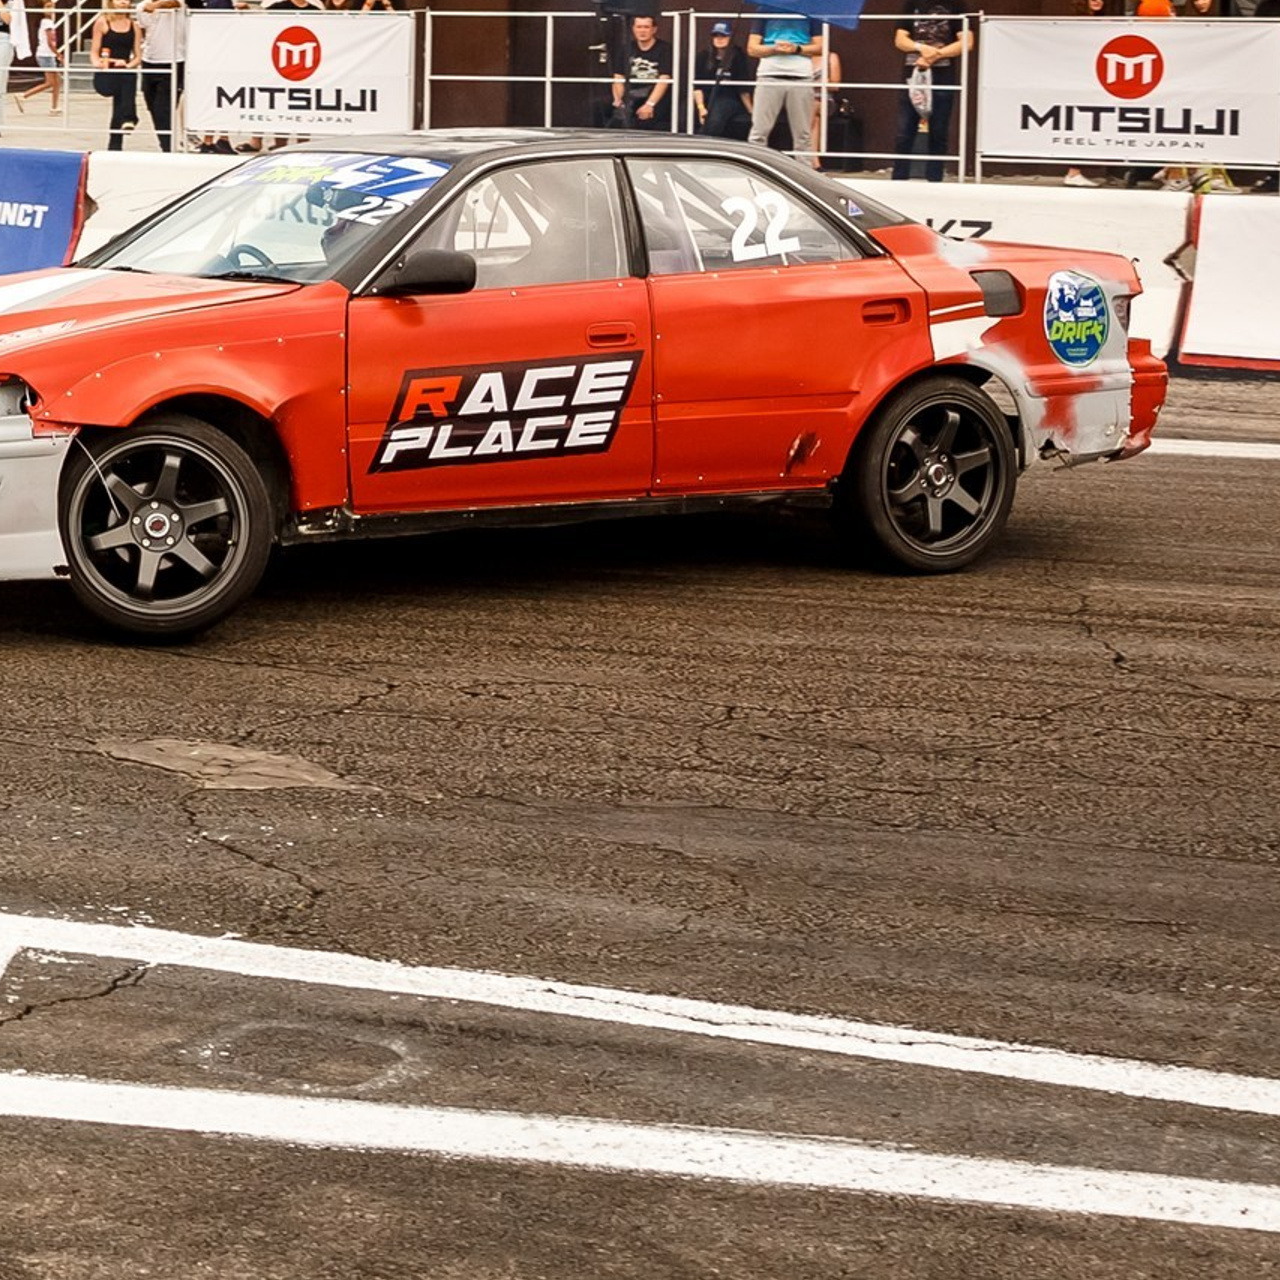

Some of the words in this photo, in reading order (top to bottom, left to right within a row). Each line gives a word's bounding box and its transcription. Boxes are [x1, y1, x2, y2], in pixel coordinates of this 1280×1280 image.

[217, 86, 377, 112] MITSUJI
[240, 114, 271, 122] FEEL
[1020, 104, 1240, 136] MITSUJI
[1052, 137, 1097, 146] FEEL
[1105, 138, 1137, 147] THE
[1144, 139, 1206, 149] JAPAN
[336, 196, 407, 225] 22
[721, 192, 801, 262] 22
[1050, 320, 1103, 344] DRIFT
[399, 360, 633, 420] RACE
[380, 411, 615, 463] PLACE
